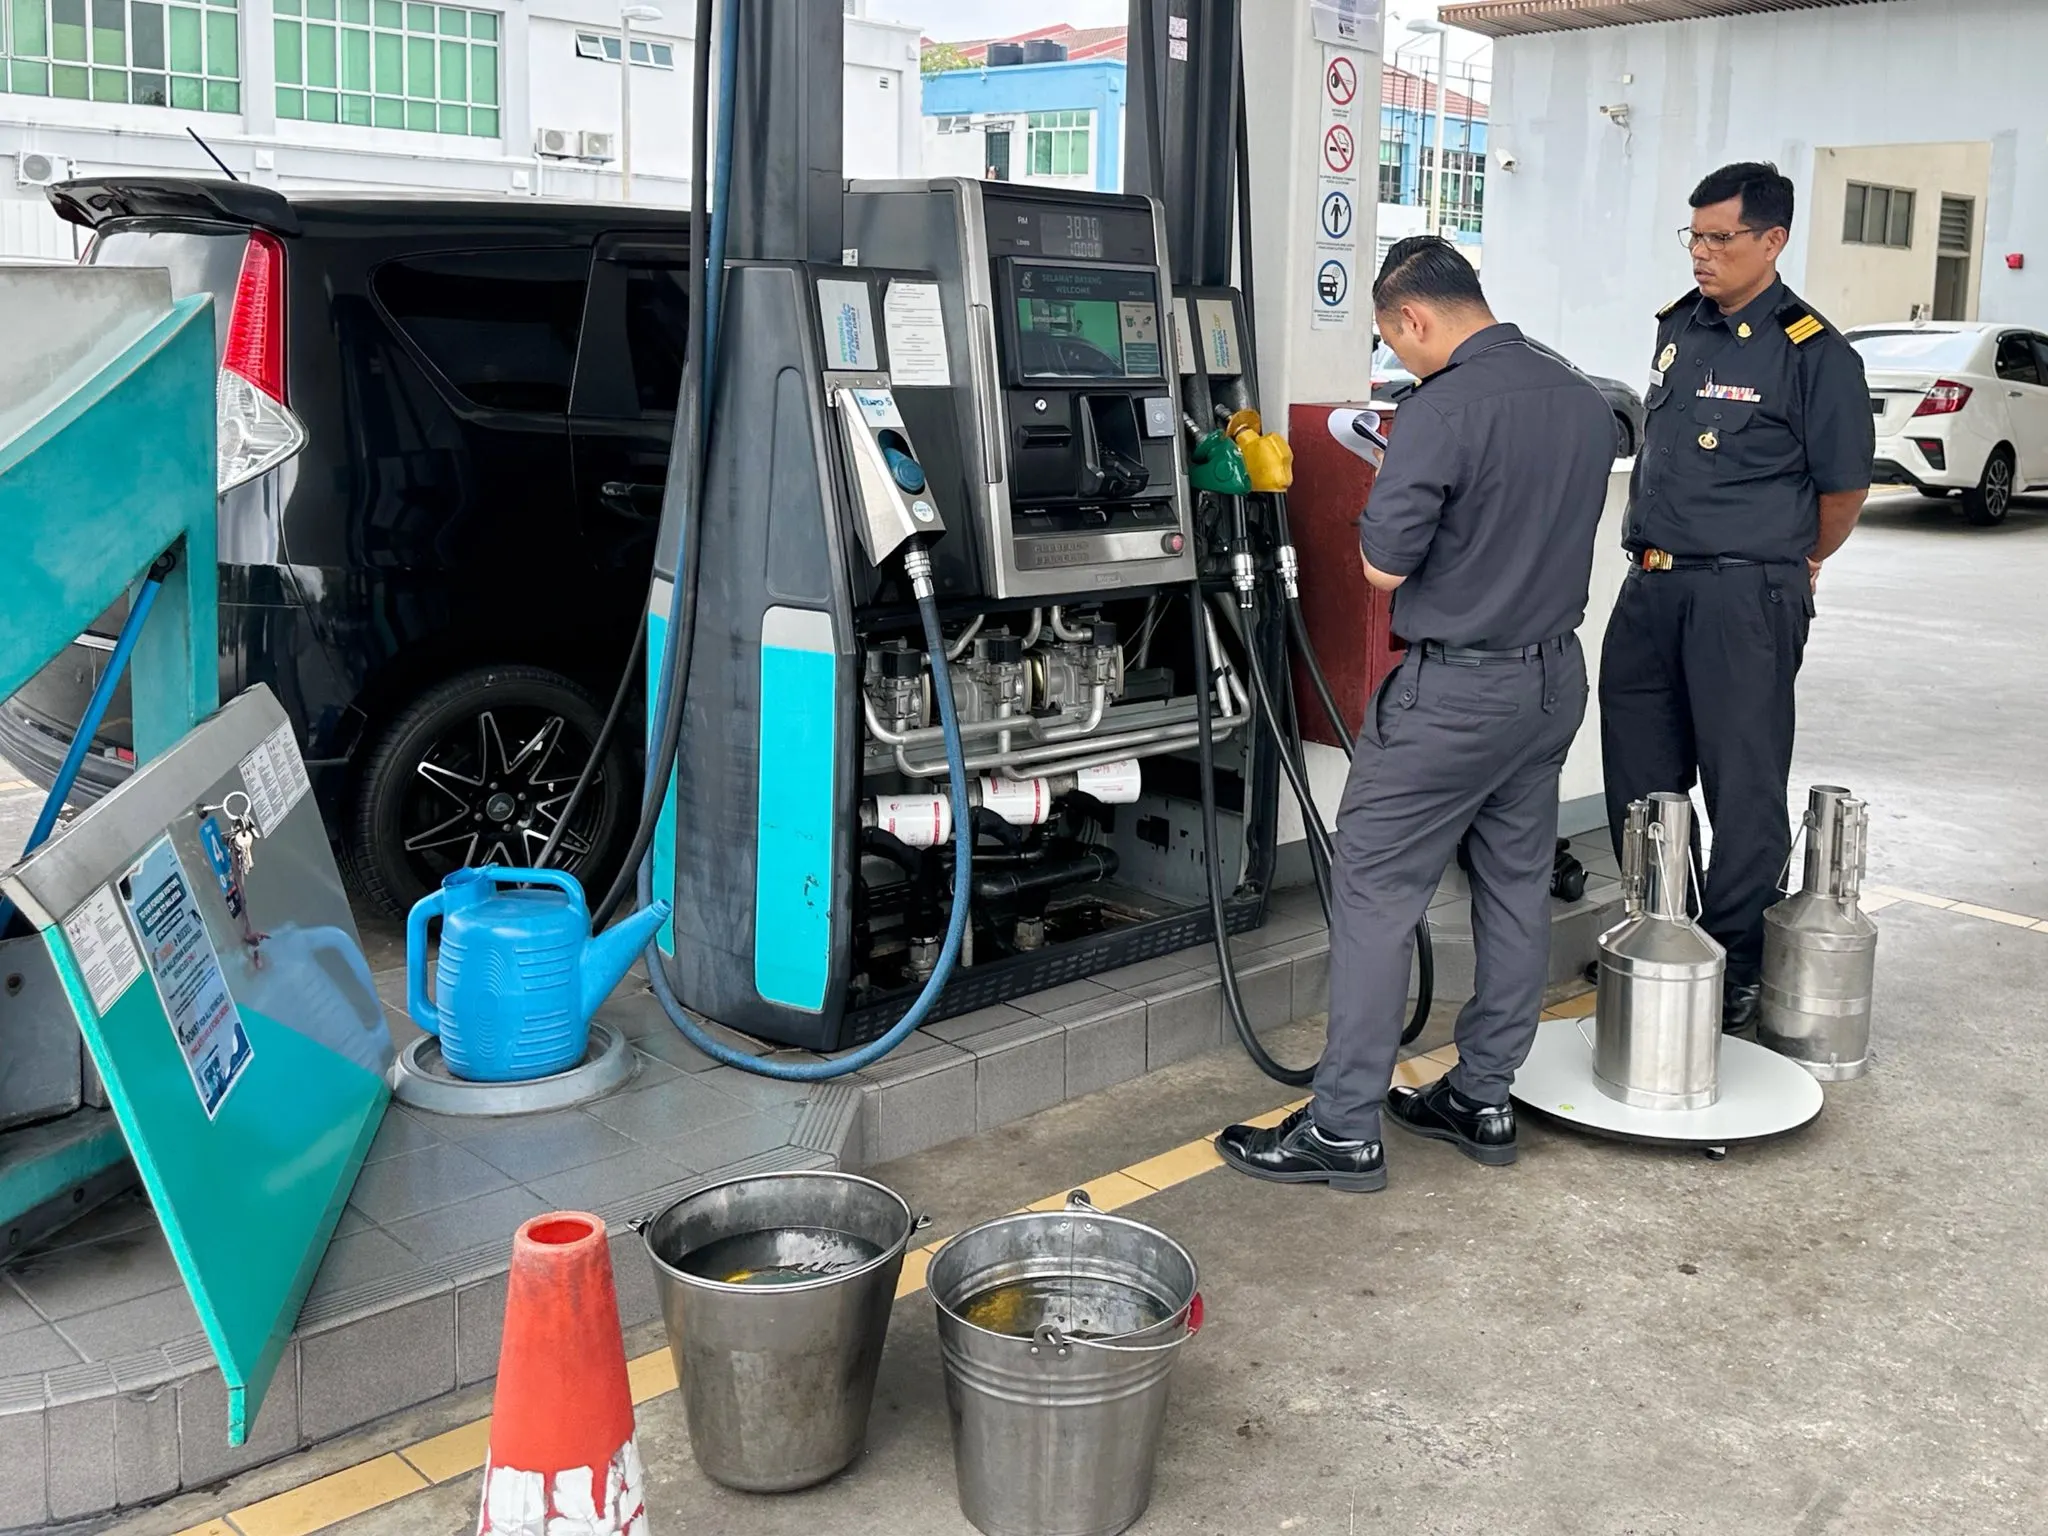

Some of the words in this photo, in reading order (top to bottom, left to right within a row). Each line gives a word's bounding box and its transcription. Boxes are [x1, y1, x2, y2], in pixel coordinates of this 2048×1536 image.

[1017, 216, 1028, 225] RM
[1042, 273, 1073, 283] SELAMAT
[1056, 286, 1091, 294] WELCOME
[842, 303, 857, 365] DYNAMIC
[837, 315, 848, 363] PETRONAS
[860, 397, 884, 406] Euro
[885, 397, 892, 406] 5
